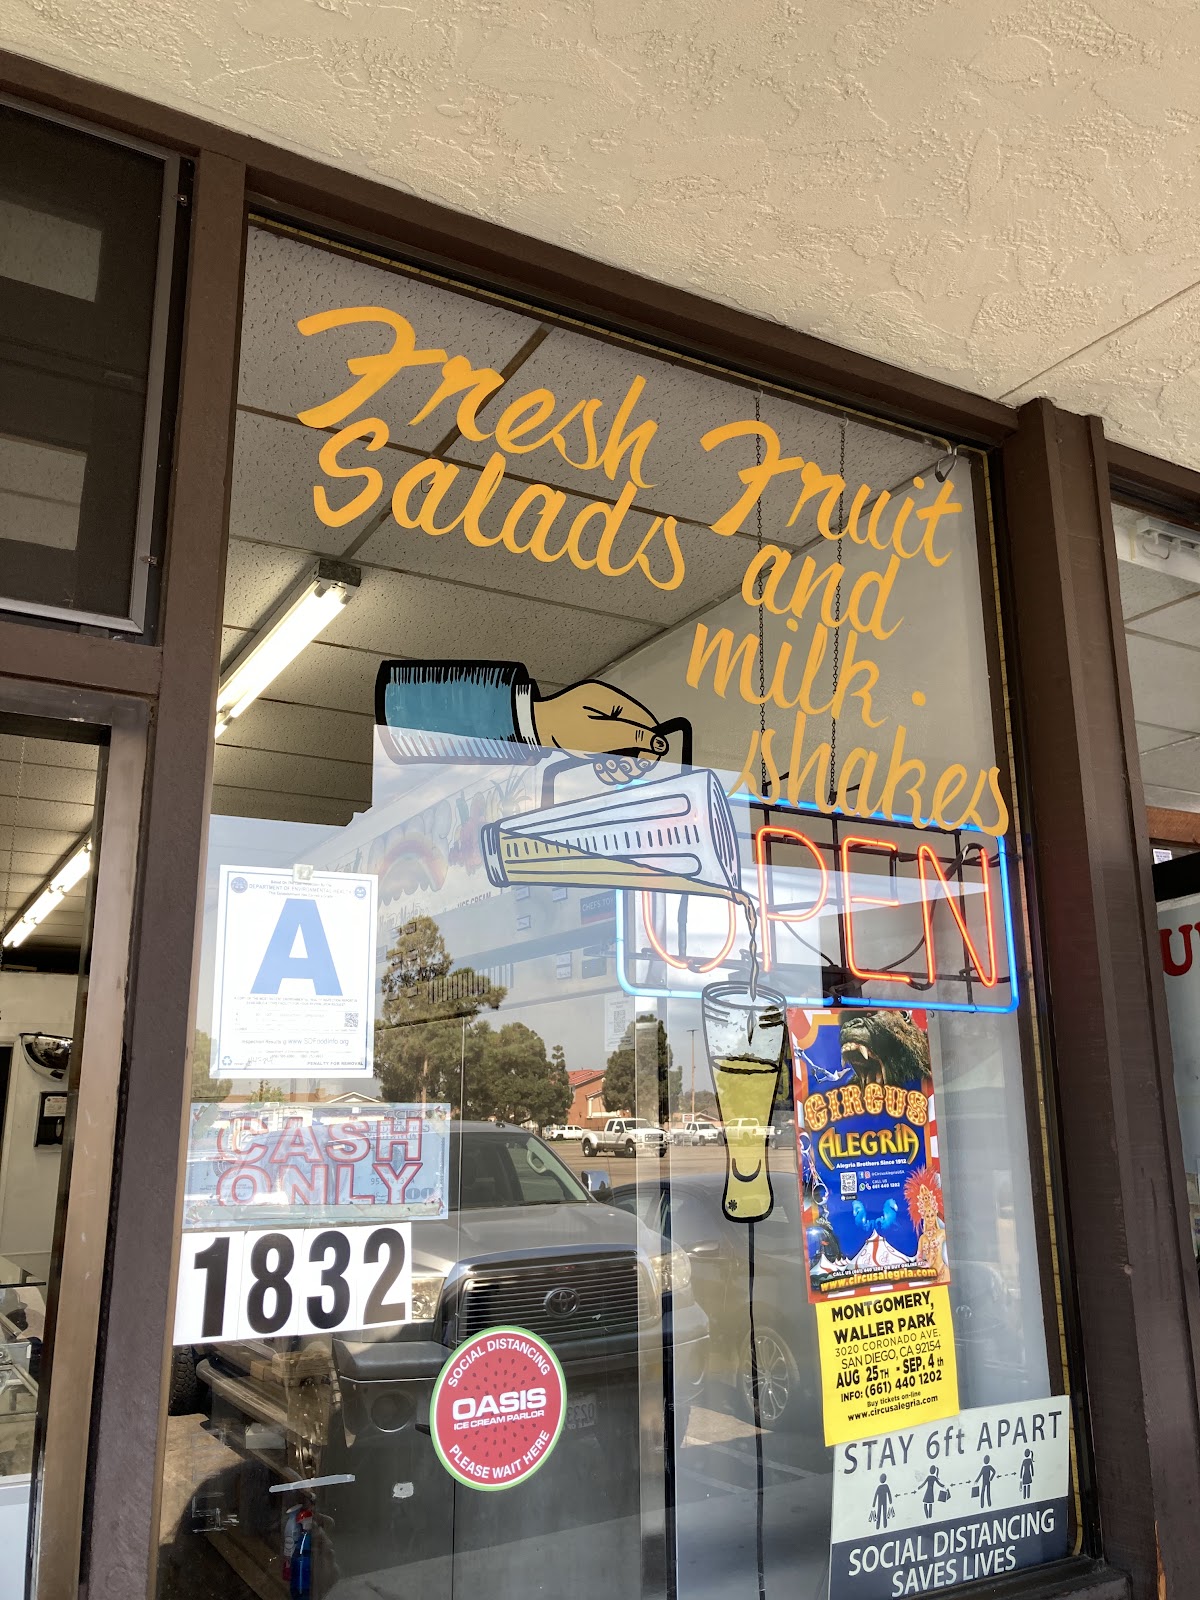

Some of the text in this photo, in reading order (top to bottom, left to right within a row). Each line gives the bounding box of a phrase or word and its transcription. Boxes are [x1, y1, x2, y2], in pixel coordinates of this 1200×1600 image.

[297, 306, 963, 567] Fresh Fruit
[313, 417, 905, 640] Salads and
[727, 711, 1009, 836] shakes
[641, 824, 998, 988] OPEN
[250, 898, 343, 996] A
[803, 1082, 929, 1131] CIRCUS
[217, 1116, 423, 1165] CASH
[216, 1162, 423, 1206] ONLY
[193, 1227, 406, 1338] 1832
[820, 1268, 938, 1291] www.circusalegria.com
[831, 1290, 934, 1322] MONTGOMERY,
[833, 1312, 936, 1345] WALLER PARK
[448, 1338, 550, 1388] SOCIAL DISTANCING
[835, 1328, 941, 1357] 3020 CORONADO AVE.
[841, 1340, 942, 1369] SAN DIEGO, CA 92154
[836, 1368, 860, 1389] AUG
[840, 1369, 943, 1402] INFO: (661) 440 1202
[867, 1400, 879, 1408] Buy
[880, 1394, 900, 1405] tickets
[452, 1387, 547, 1421] OASIS
[453, 1409, 544, 1430] ICE CREAM PARLOR
[847, 1394, 939, 1421] www.circusalegria.com
[449, 1429, 550, 1479] PLEASE WAIT HERE
[843, 1410, 1062, 1475] STAY 6ft APART
[848, 1508, 1055, 1576] SOCIAL DISTANCING
[891, 1546, 1017, 1598] SAVES LIVES
